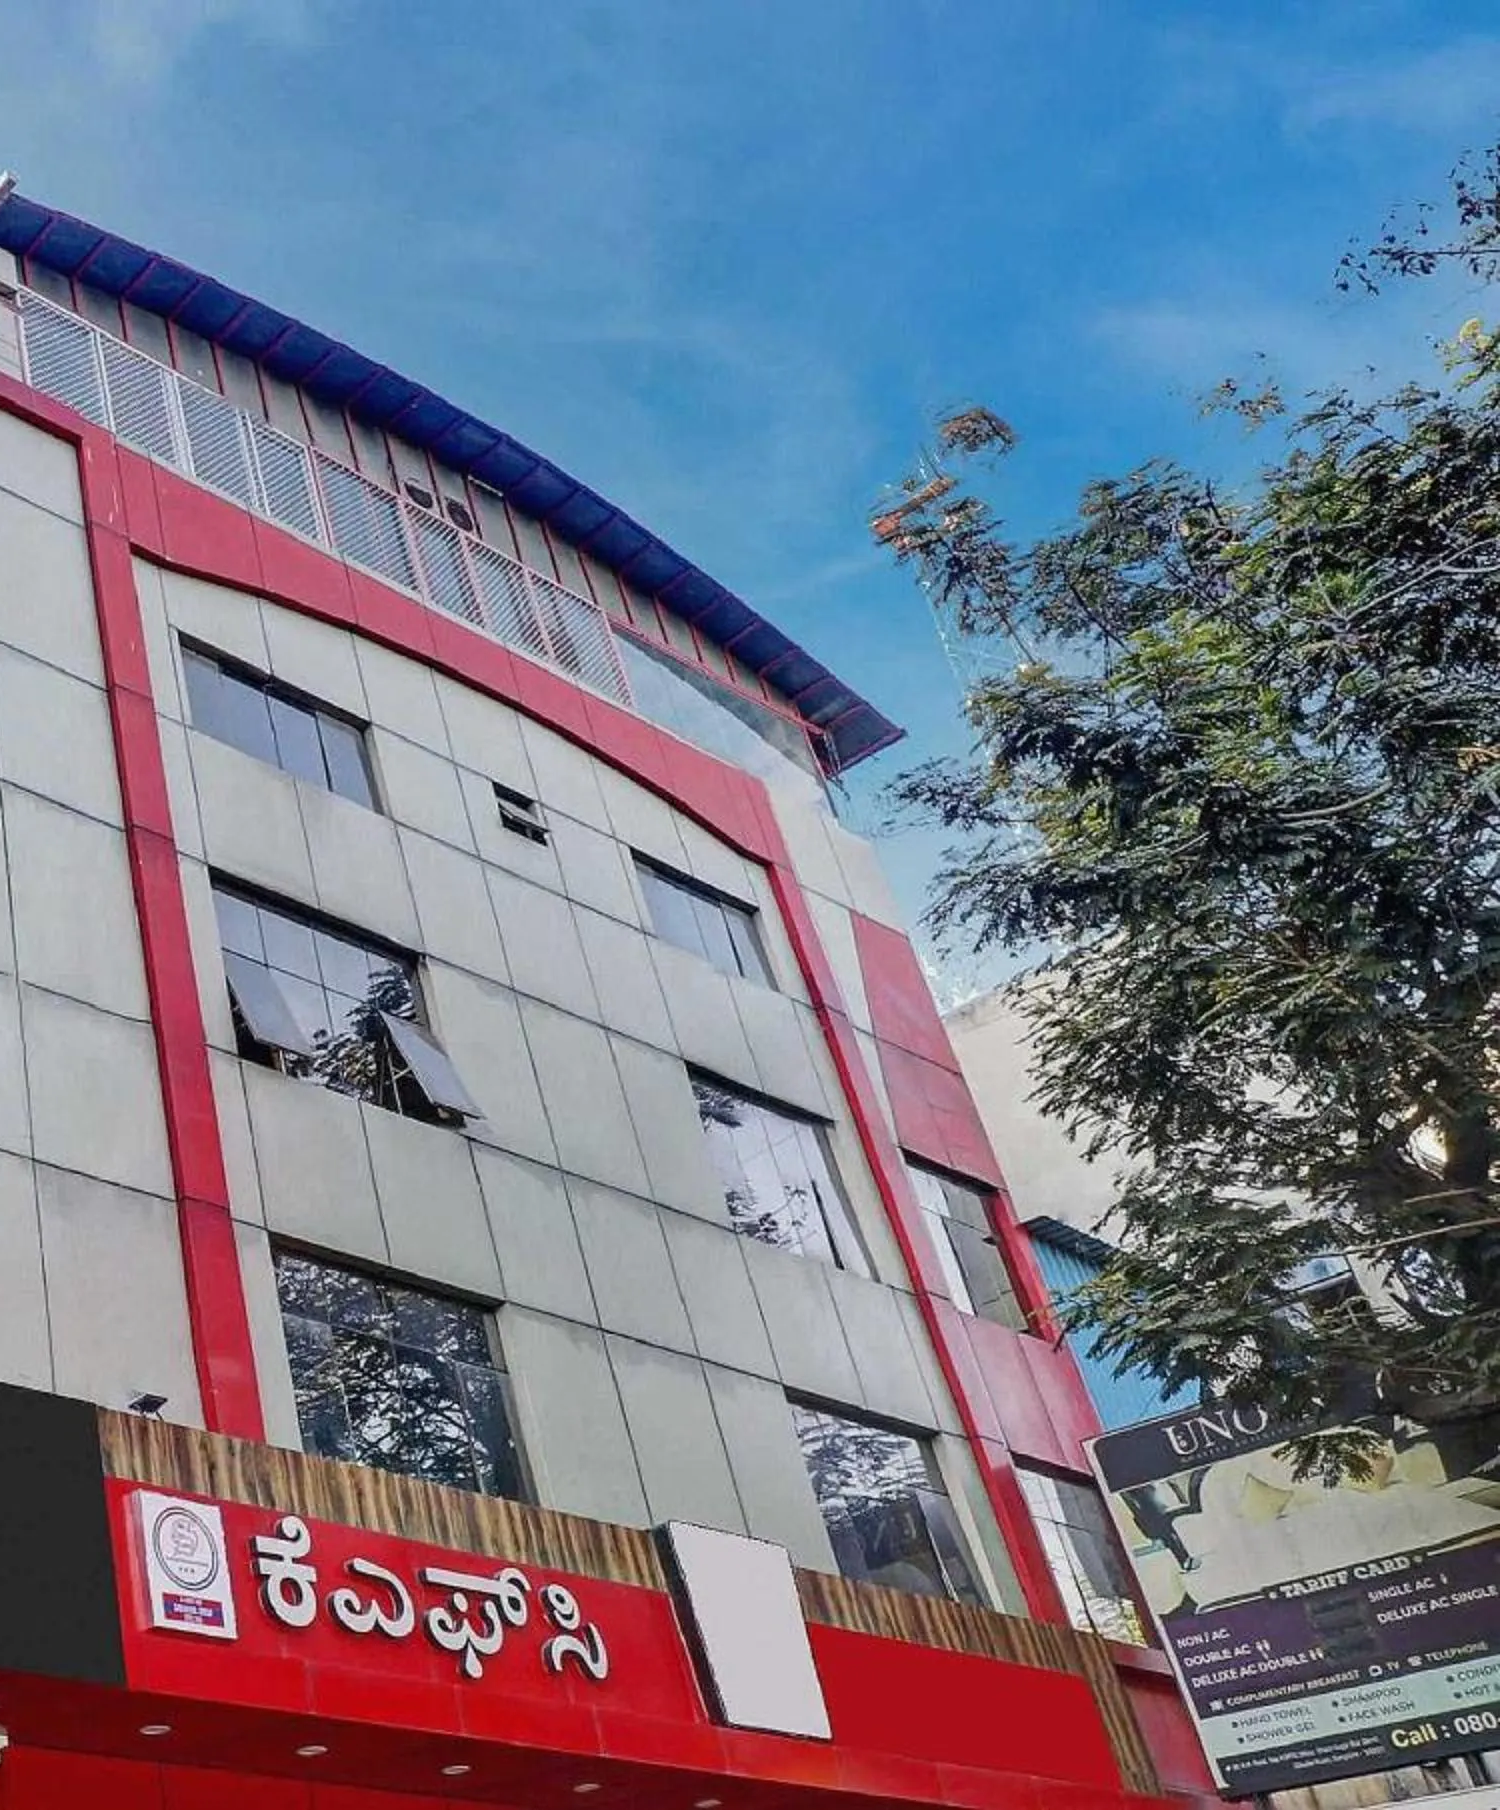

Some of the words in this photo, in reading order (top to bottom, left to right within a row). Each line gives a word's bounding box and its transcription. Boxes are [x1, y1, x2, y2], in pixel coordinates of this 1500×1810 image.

[1280, 1570, 1348, 1598] TARIFF
[1354, 1557, 1410, 1579] CARD
[1368, 1583, 1413, 1602] SINGLE
[1377, 1602, 1428, 1623] DELUXE
[1430, 1597, 1450, 1610] AC
[1451, 1585, 1499, 1604] SINGLE
[1184, 1648, 1232, 1667] DOUBLE
[1234, 1644, 1251, 1656] AC
[1386, 1661, 1399, 1672] TV
[1191, 1668, 1239, 1688] DELUXE
[1240, 1663, 1258, 1677] AC
[1259, 1653, 1308, 1672] DOUBLE
[1464, 1684, 1490, 1696] HOT
[1349, 1708, 1378, 1721] FACE
[1381, 1700, 1415, 1715] WASH
[1391, 1723, 1438, 1748] Call
